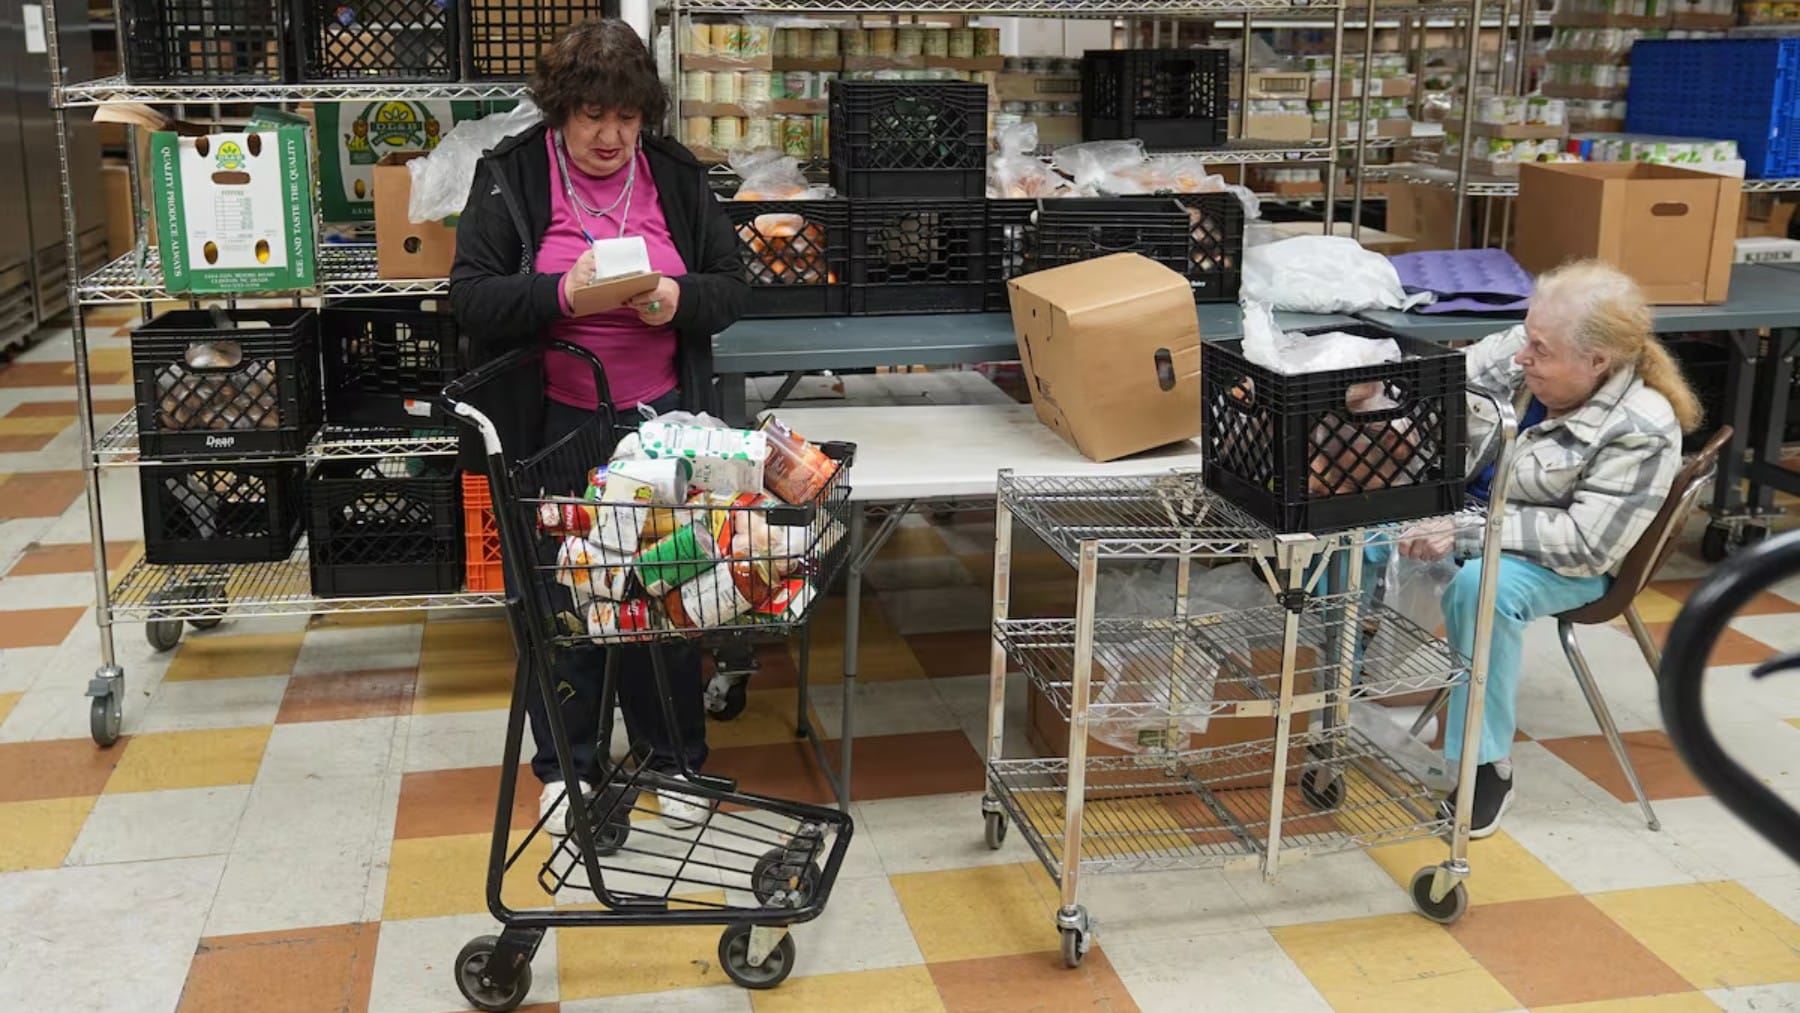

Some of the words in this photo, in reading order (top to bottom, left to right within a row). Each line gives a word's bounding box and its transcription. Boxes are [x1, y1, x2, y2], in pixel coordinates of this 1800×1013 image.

[161, 146, 173, 189] QUALITY
[287, 138, 299, 181] QUALITY
[290, 181, 299, 202] THE
[167, 190, 178, 237] PRODUCE
[291, 204, 302, 235] TASTE
[171, 238, 182, 277] ALWAYS
[293, 237, 303, 257] AND
[295, 259, 304, 278] SEE
